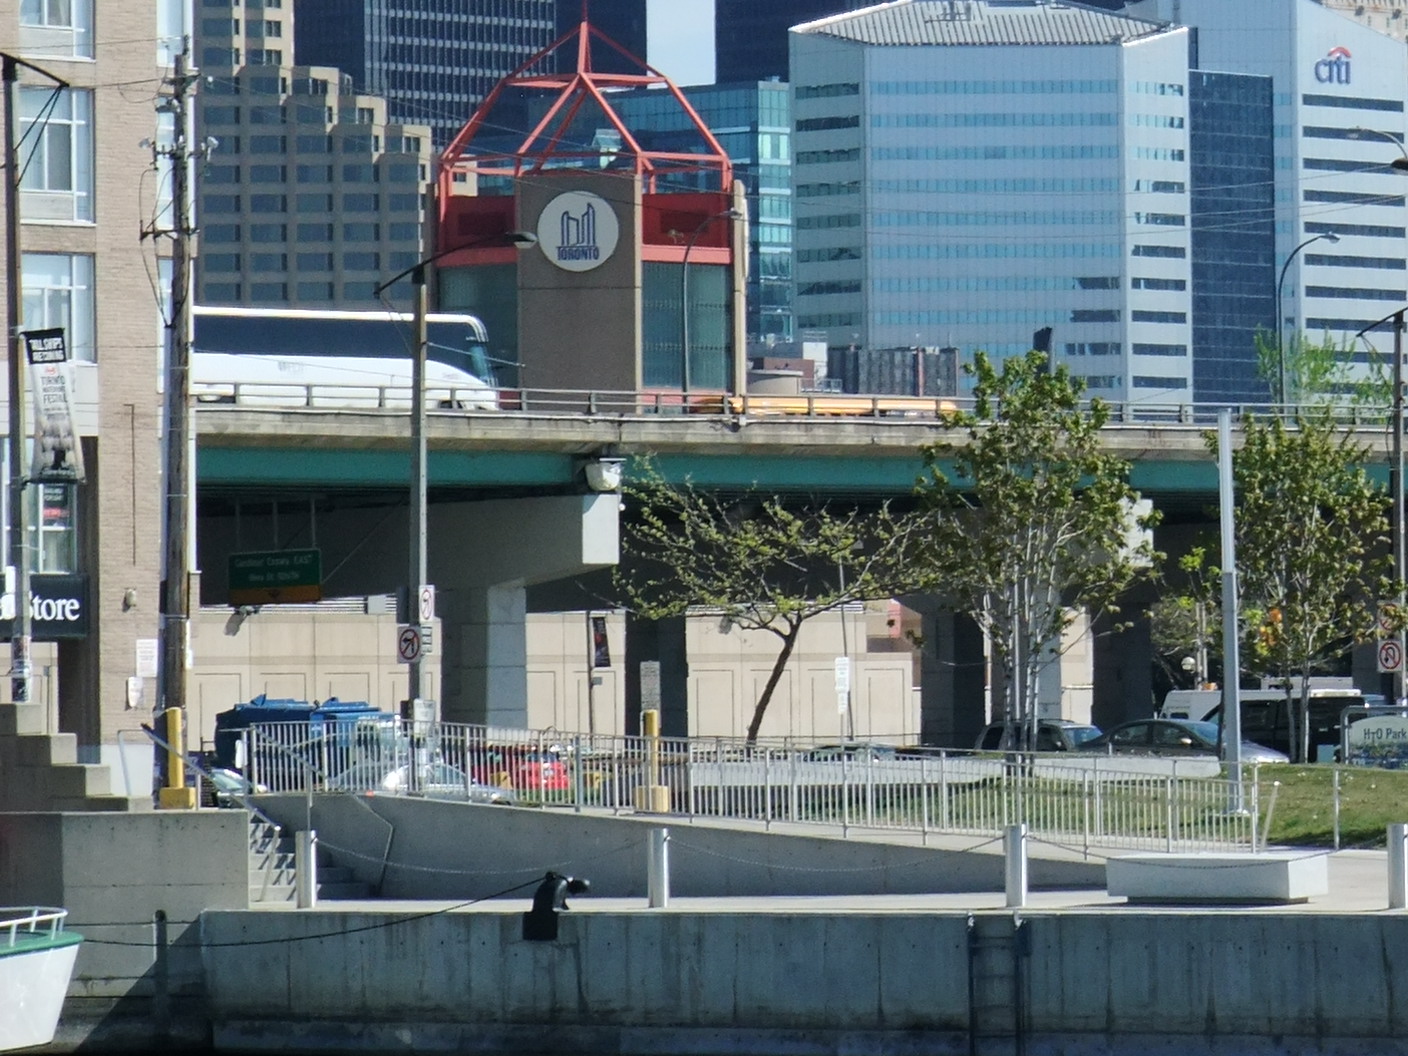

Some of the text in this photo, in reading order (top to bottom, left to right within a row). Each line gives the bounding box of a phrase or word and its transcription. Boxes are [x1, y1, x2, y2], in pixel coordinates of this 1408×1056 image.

[1314, 54, 1351, 85] citi
[556, 245, 600, 261] TORONTO
[1385, 727, 1407, 739] Park
